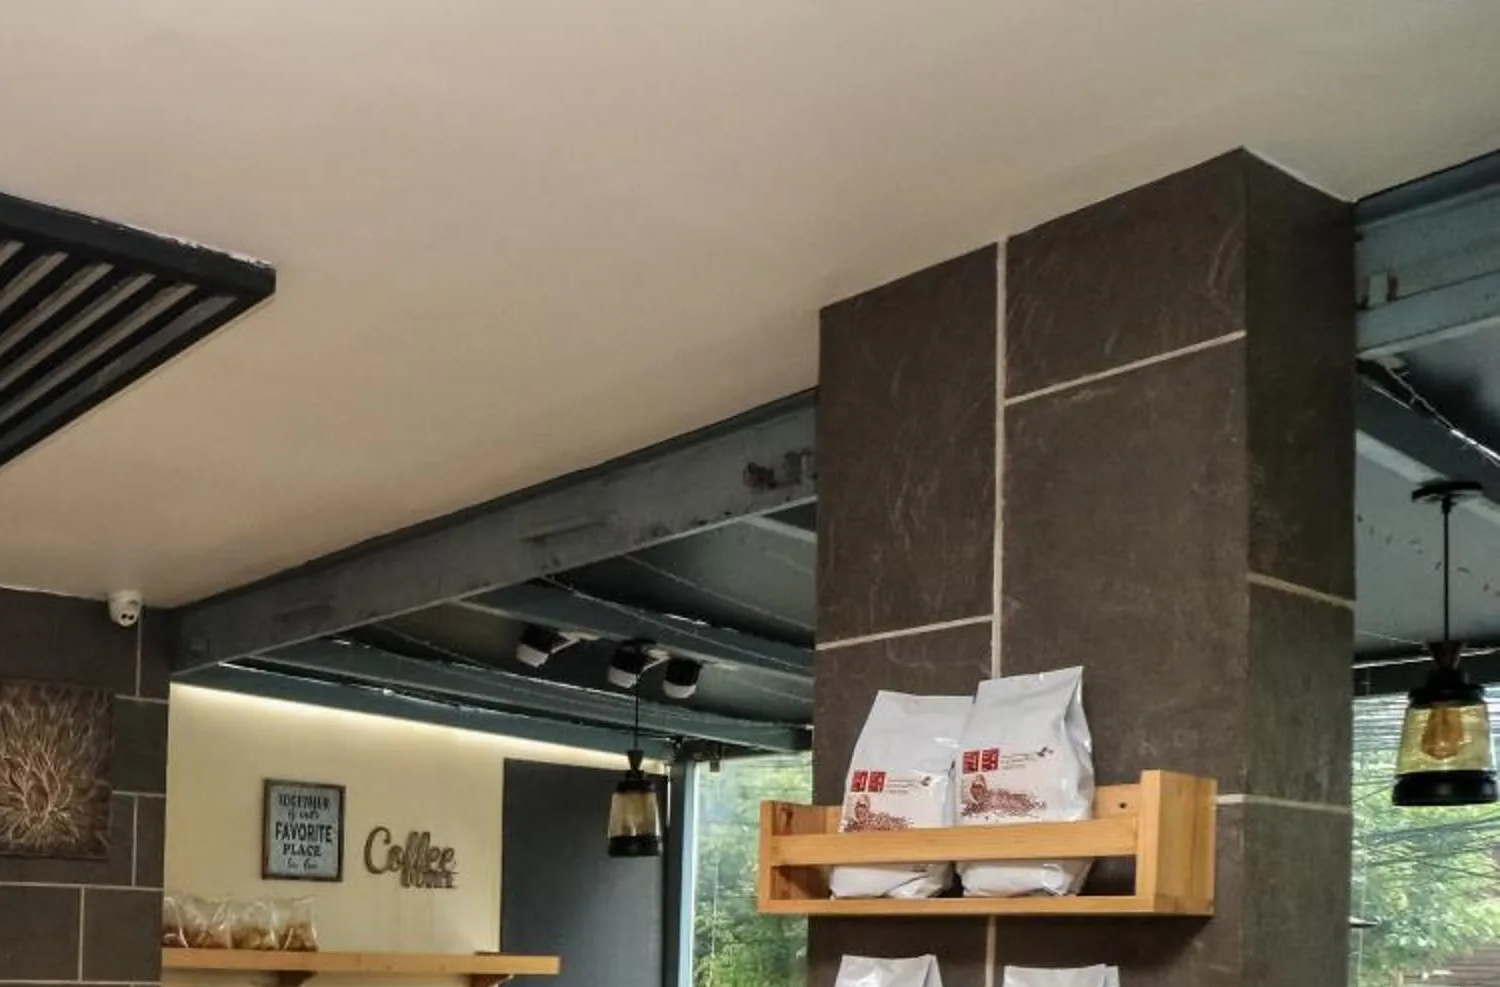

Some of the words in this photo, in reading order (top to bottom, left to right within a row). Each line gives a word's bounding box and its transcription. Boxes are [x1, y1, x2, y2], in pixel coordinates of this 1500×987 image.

[275, 821, 333, 844] FAVORITE
[282, 843, 322, 857] PLACE
[364, 826, 457, 874] Coffee
